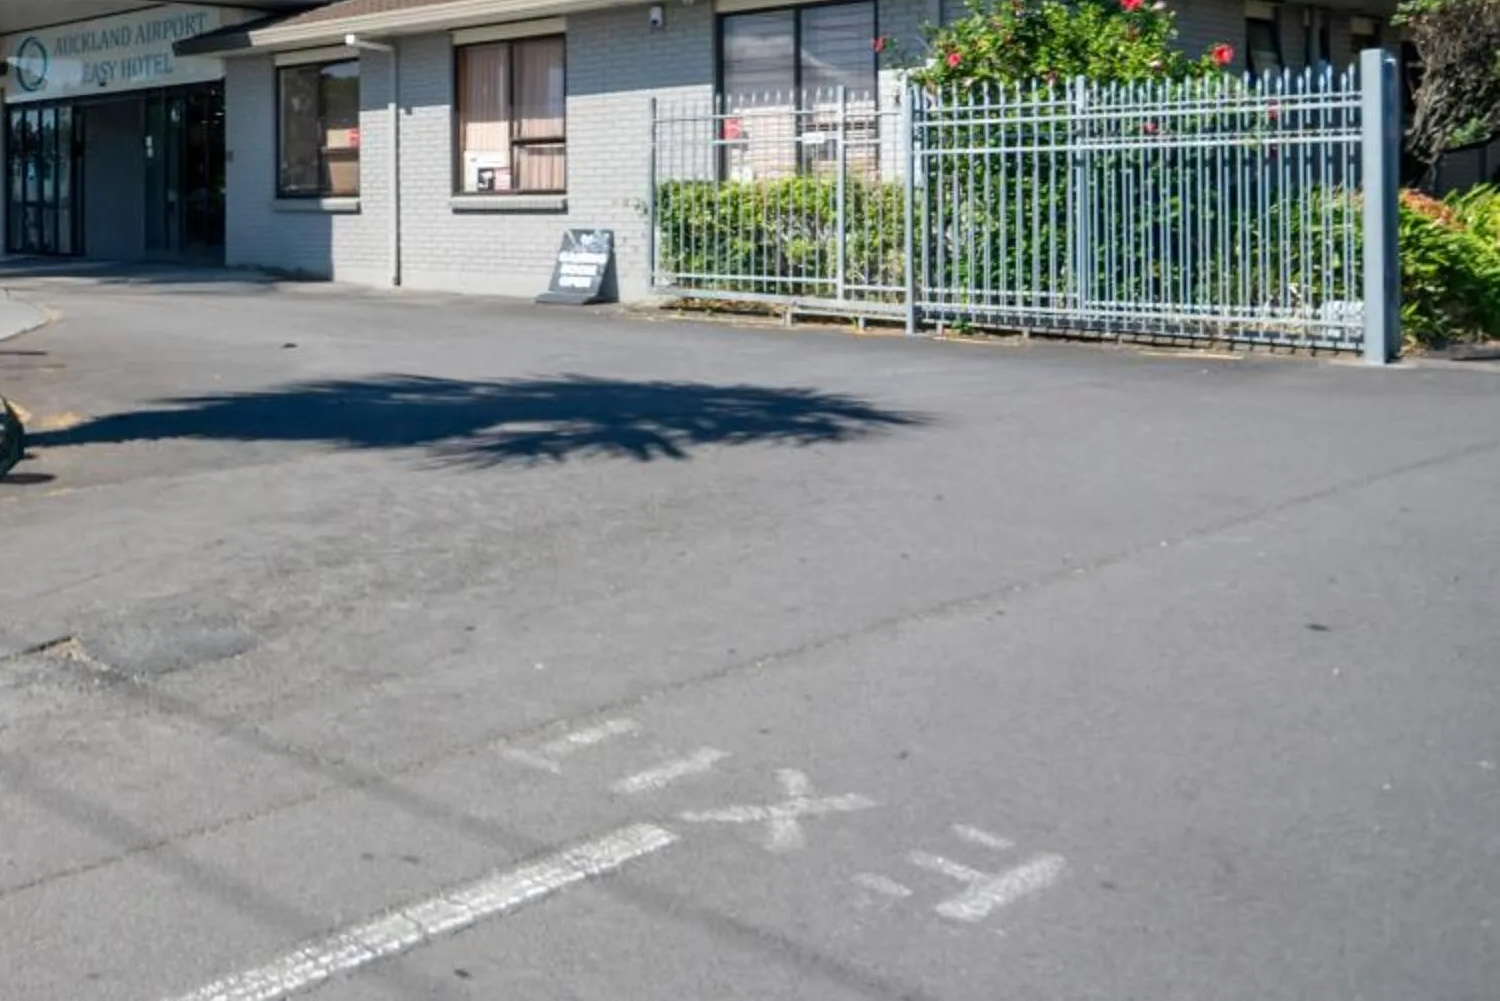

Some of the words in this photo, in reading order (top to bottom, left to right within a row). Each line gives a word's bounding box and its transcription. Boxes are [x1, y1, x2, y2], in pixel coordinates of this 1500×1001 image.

[54, 26, 132, 56] AUCKLAND
[135, 11, 208, 46] AIRPORT
[82, 60, 118, 84] EASY
[121, 53, 175, 79] HOTEL
[501, 716, 1068, 924] EXIT
